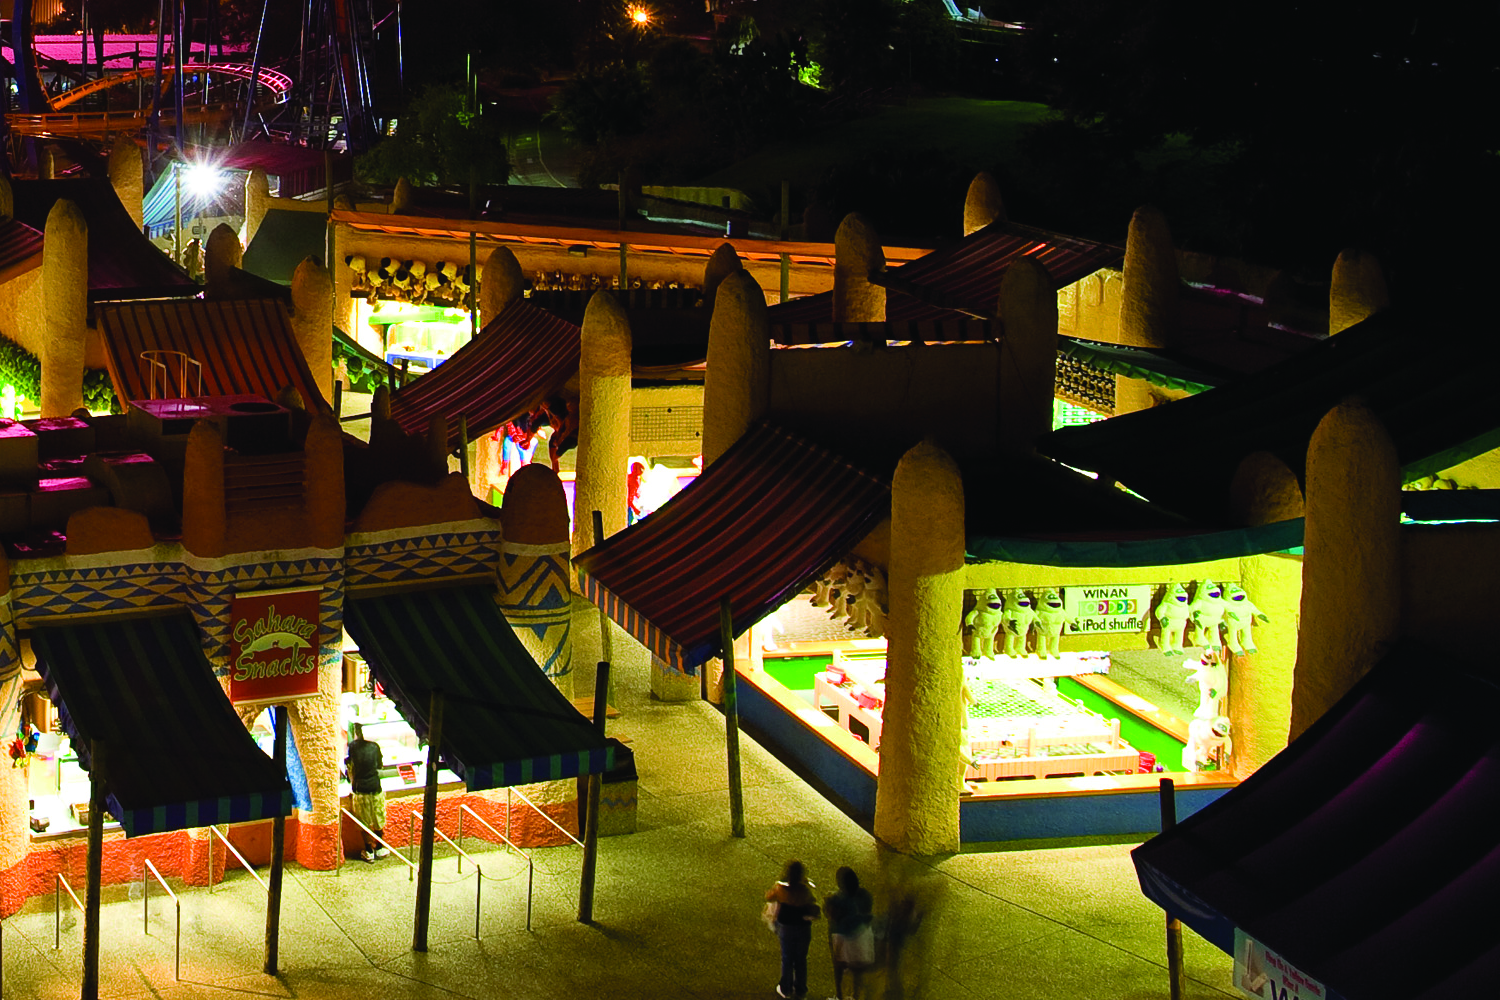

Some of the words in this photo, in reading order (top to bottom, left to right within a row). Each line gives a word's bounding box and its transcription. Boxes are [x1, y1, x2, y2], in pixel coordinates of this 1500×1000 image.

[1083, 588, 1108, 598] WIN
[1110, 588, 1128, 598] AN
[233, 604, 317, 652] Sahara
[1082, 618, 1106, 631] iPod
[1108, 617, 1143, 630] shuffle
[234, 641, 315, 681] Snacks
